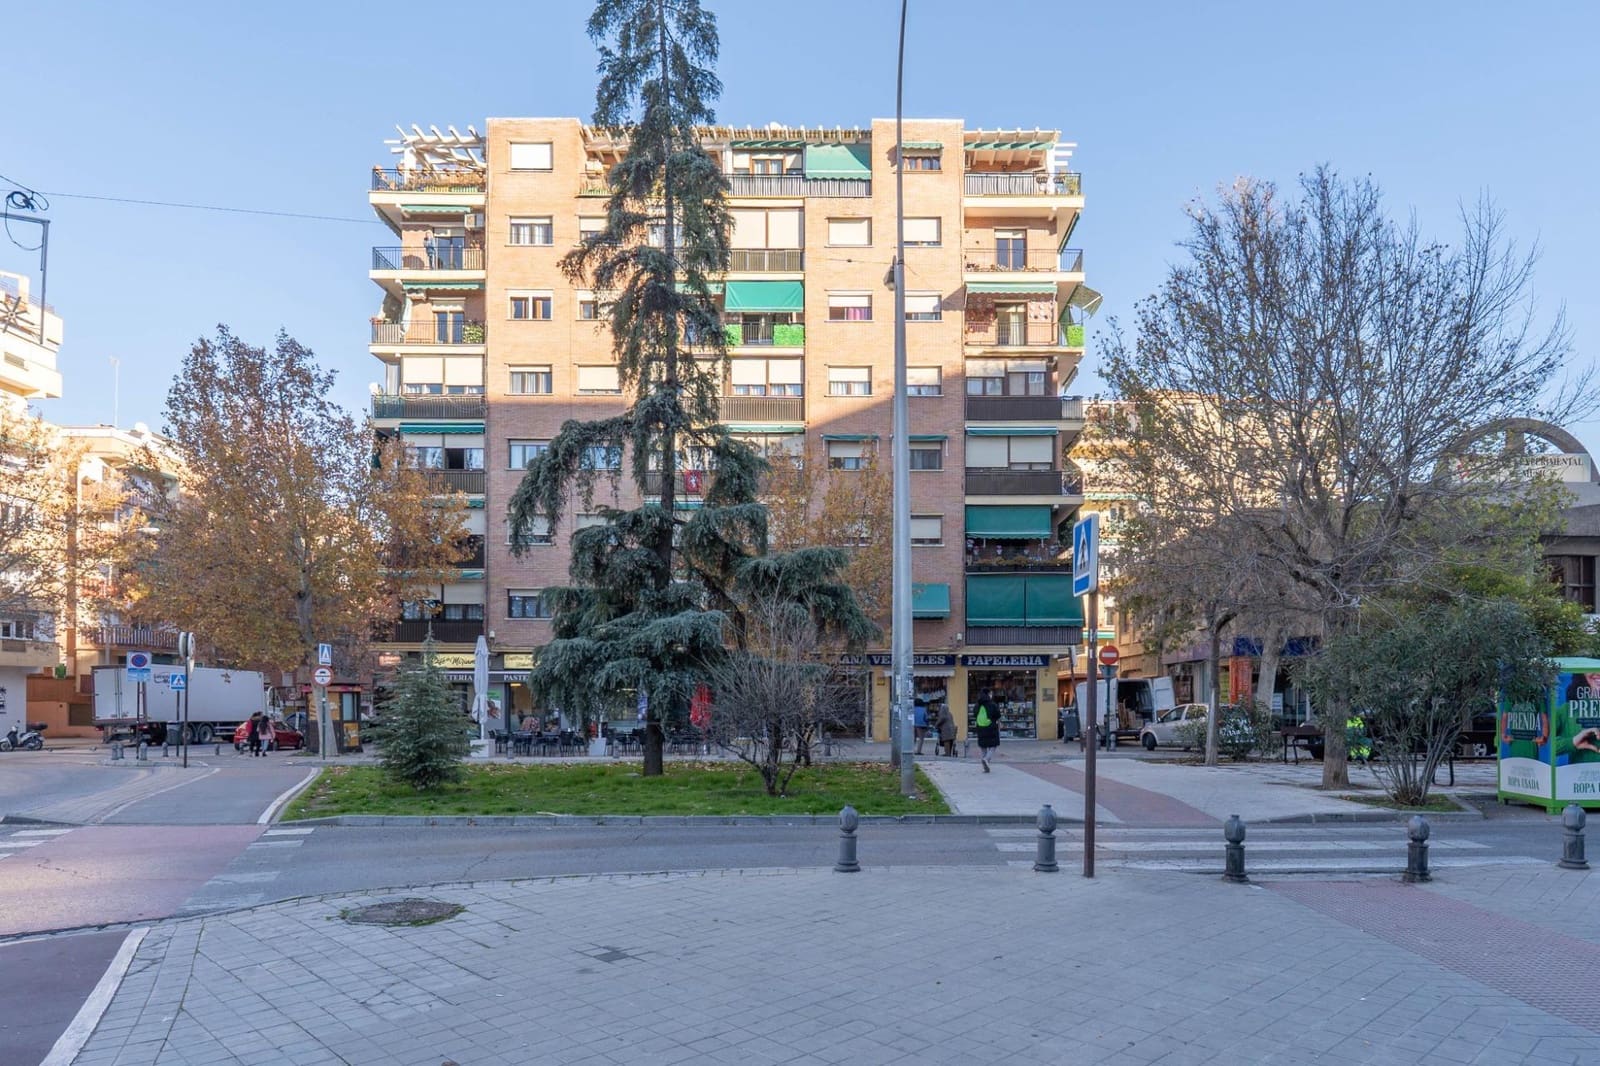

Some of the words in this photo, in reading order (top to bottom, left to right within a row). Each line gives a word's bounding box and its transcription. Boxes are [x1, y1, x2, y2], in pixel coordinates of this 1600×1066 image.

[872, 655, 946, 665] VEELES
[967, 655, 1043, 665] PAPELERIA
[1567, 700, 1600, 718] PRE
[1507, 712, 1541, 731] PRENDA
[1573, 782, 1596, 793] ROPA
